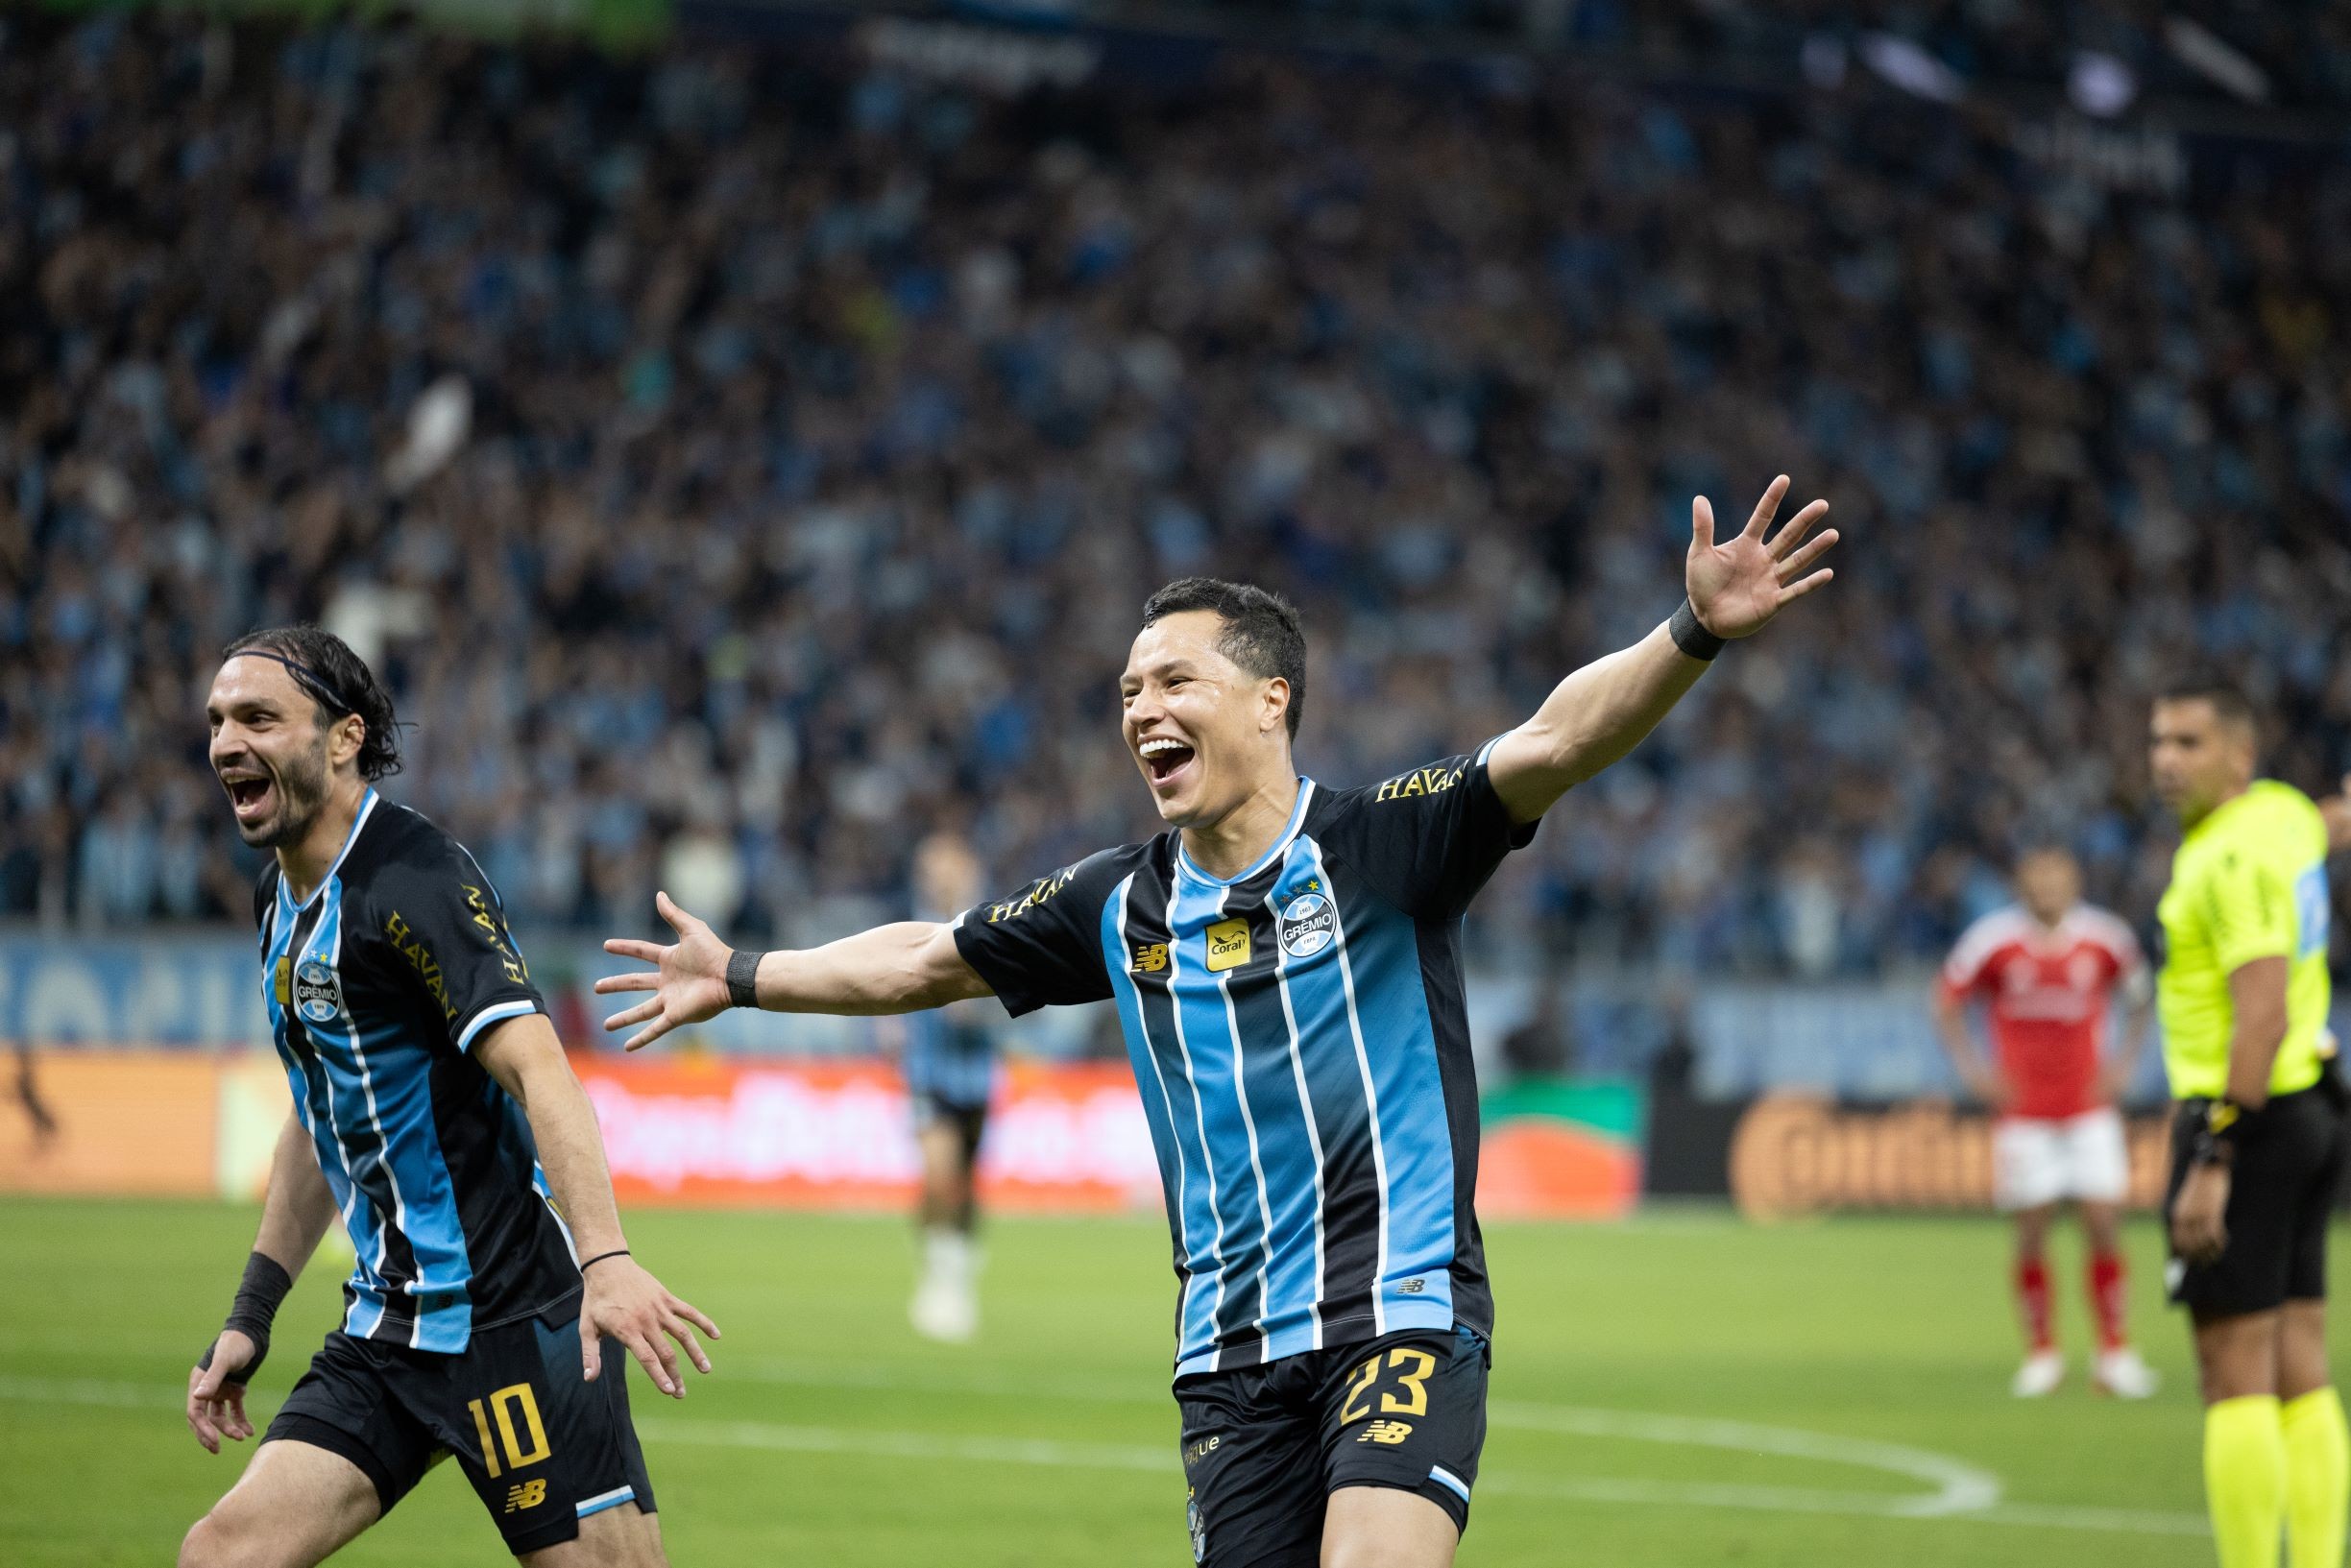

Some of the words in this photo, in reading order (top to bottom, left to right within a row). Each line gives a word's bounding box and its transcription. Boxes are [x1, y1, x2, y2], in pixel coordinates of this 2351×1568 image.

[1375, 759, 1470, 803] HAVAN
[1284, 912, 1332, 941] GRÊMIO
[1211, 939, 1242, 955] Coral
[298, 984, 337, 1001] GRÊMIO
[1340, 1348, 1436, 1425] 23
[468, 1383, 551, 1479] 10
